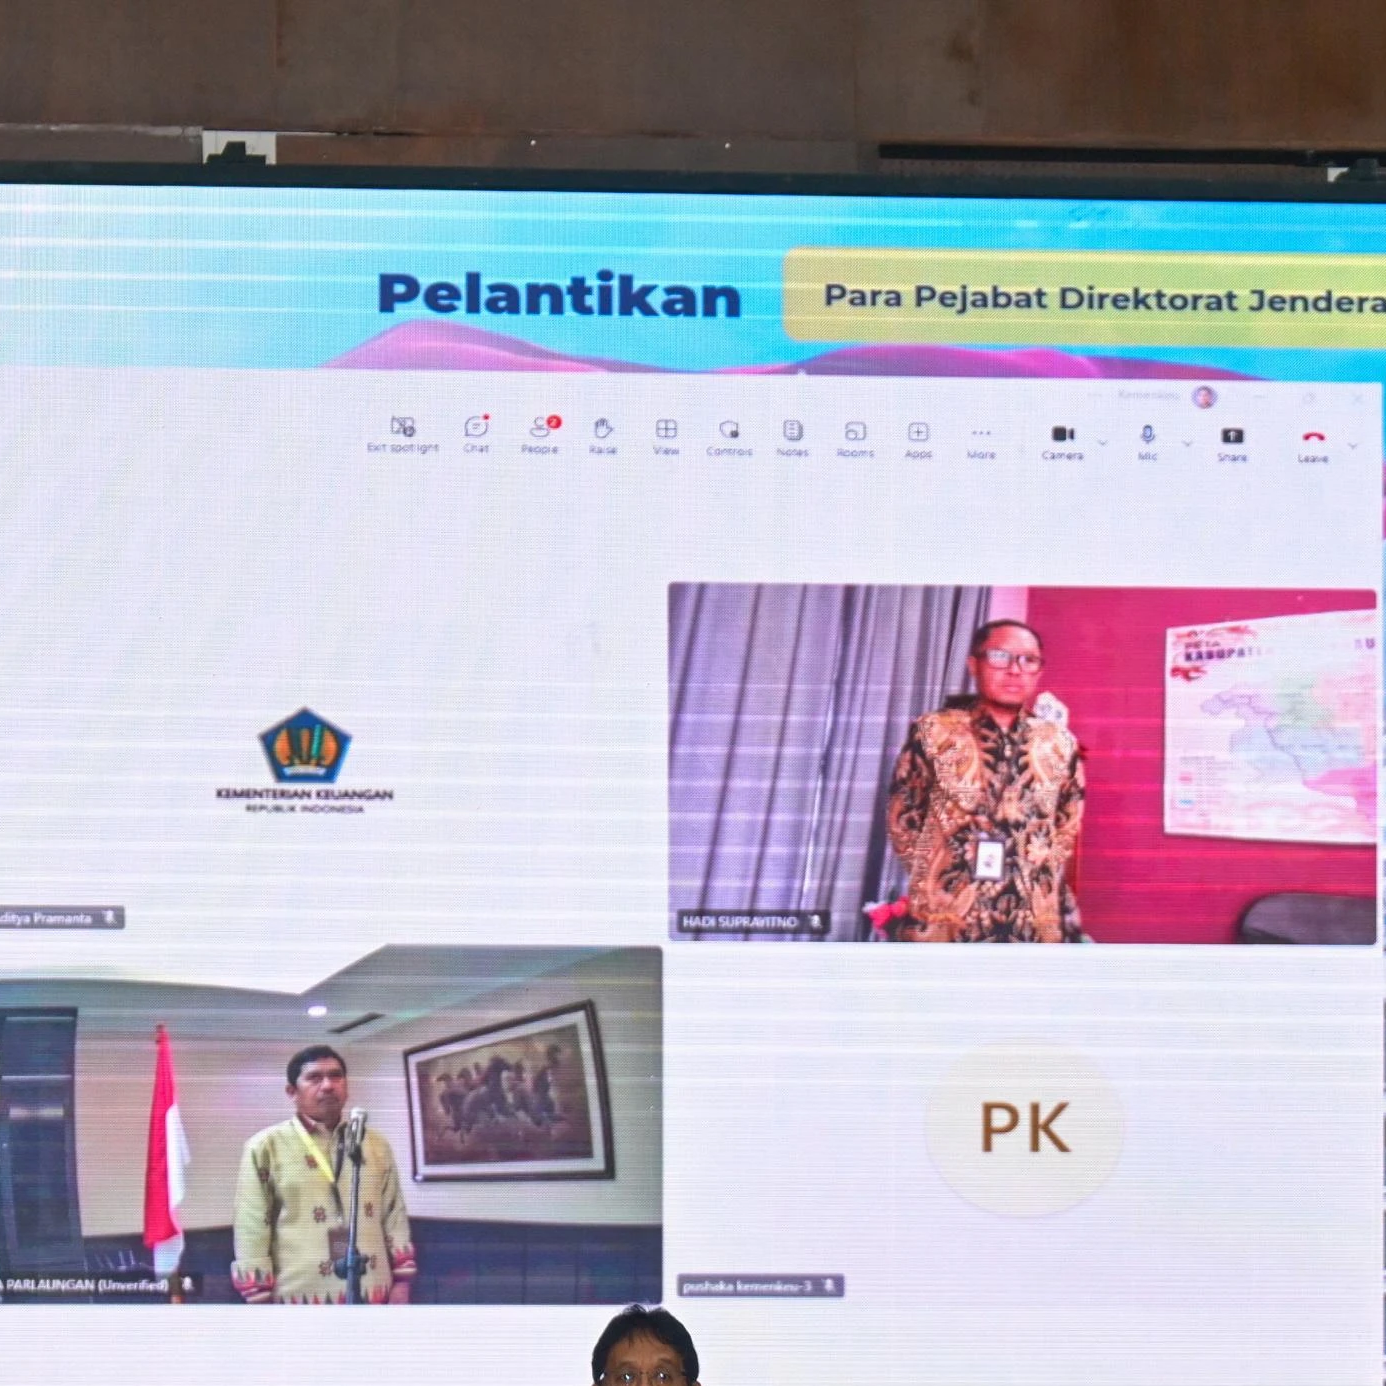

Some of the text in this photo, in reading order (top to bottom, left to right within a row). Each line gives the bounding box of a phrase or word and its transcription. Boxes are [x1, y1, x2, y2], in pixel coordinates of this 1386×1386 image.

[378, 269, 741, 318] Pelantikan
[825, 284, 902, 308] Para
[914, 284, 1047, 314] Pejabat
[1059, 286, 1238, 313] Direktorat
[1042, 450, 1084, 461] Camera
[1297, 453, 1329, 464] Leave
[216, 787, 395, 801] KEMENTERIAN KEUANGAN
[245, 804, 365, 814] REPUBLIK INDONESIA
[683, 915, 715, 928] HADI
[981, 1101, 1072, 1153] PK
[6, 1277, 94, 1292] PARLAUNGAN
[97, 1276, 169, 1293] (Unverified)
